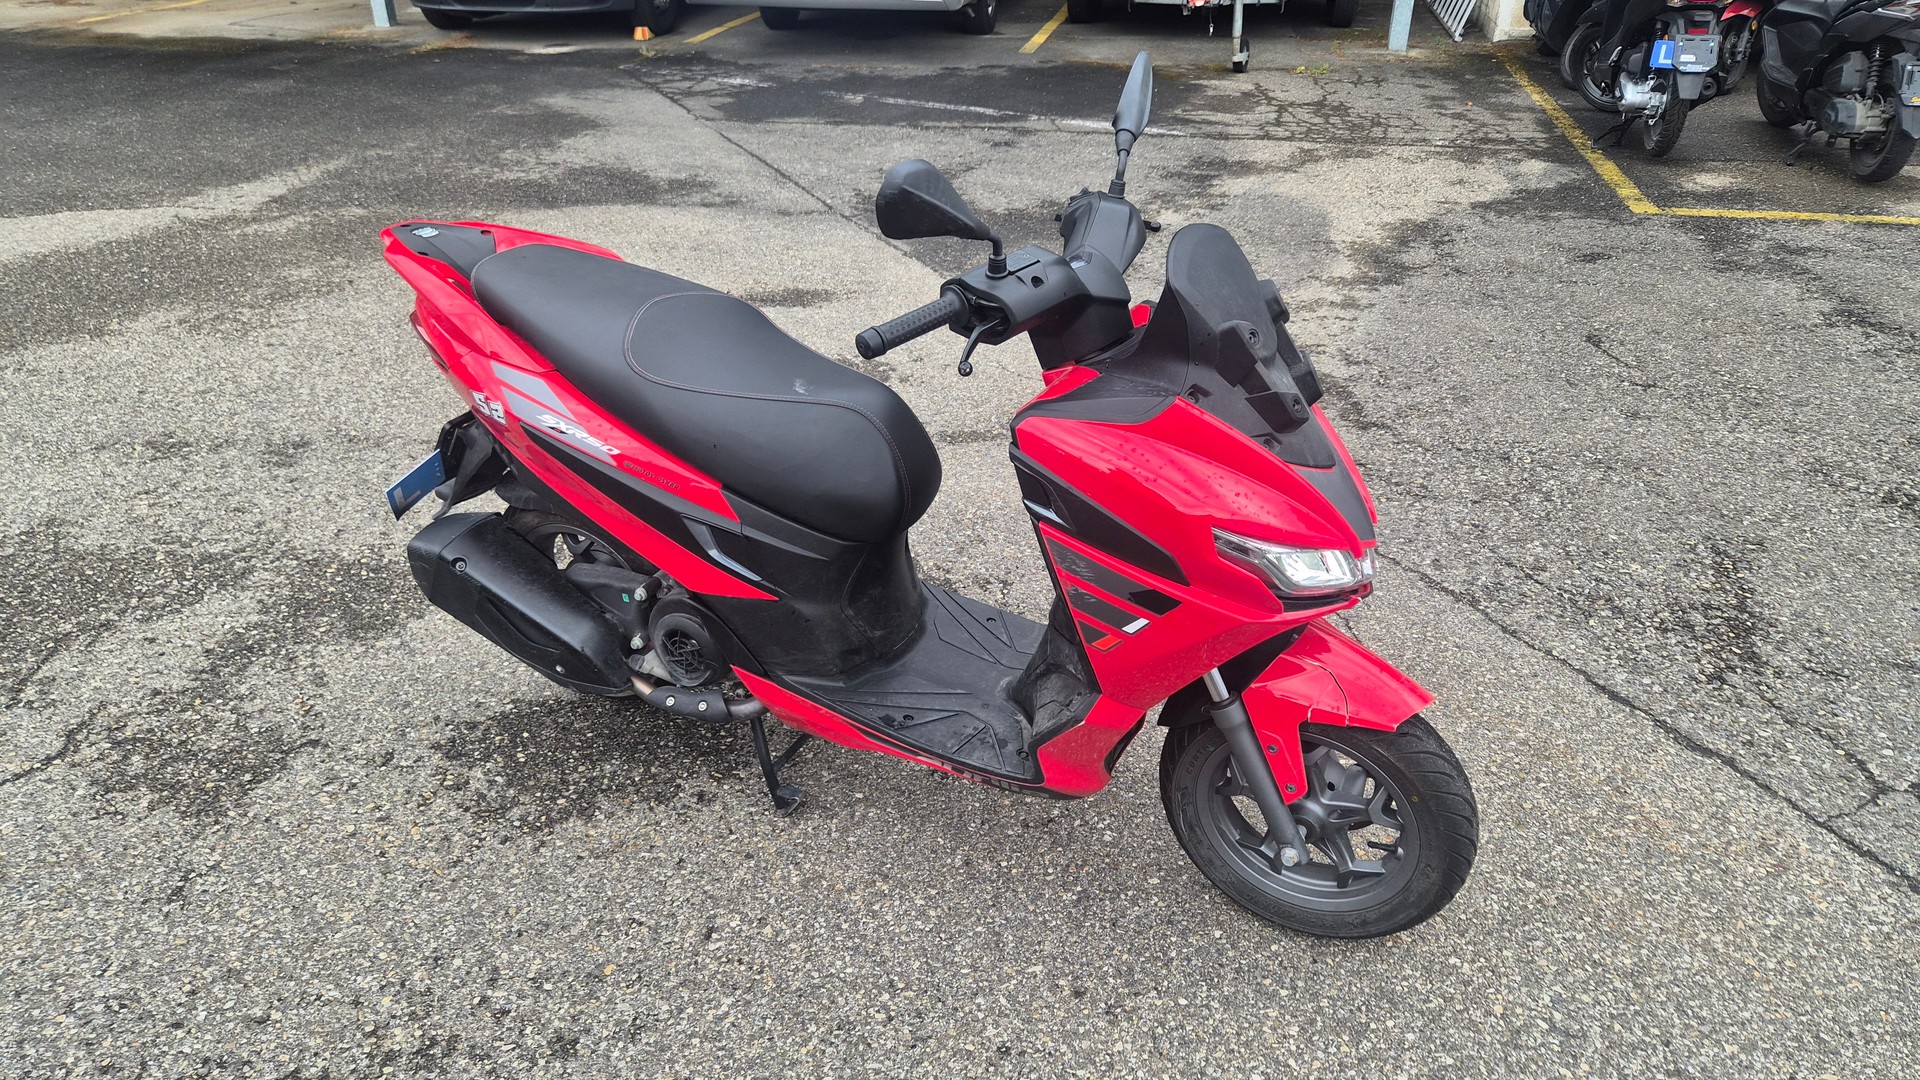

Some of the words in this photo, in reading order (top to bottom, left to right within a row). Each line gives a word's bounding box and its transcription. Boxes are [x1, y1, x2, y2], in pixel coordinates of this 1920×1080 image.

[1658, 44, 1672, 64] L
[536, 414, 622, 455] SXR50
[393, 487, 421, 511] L
